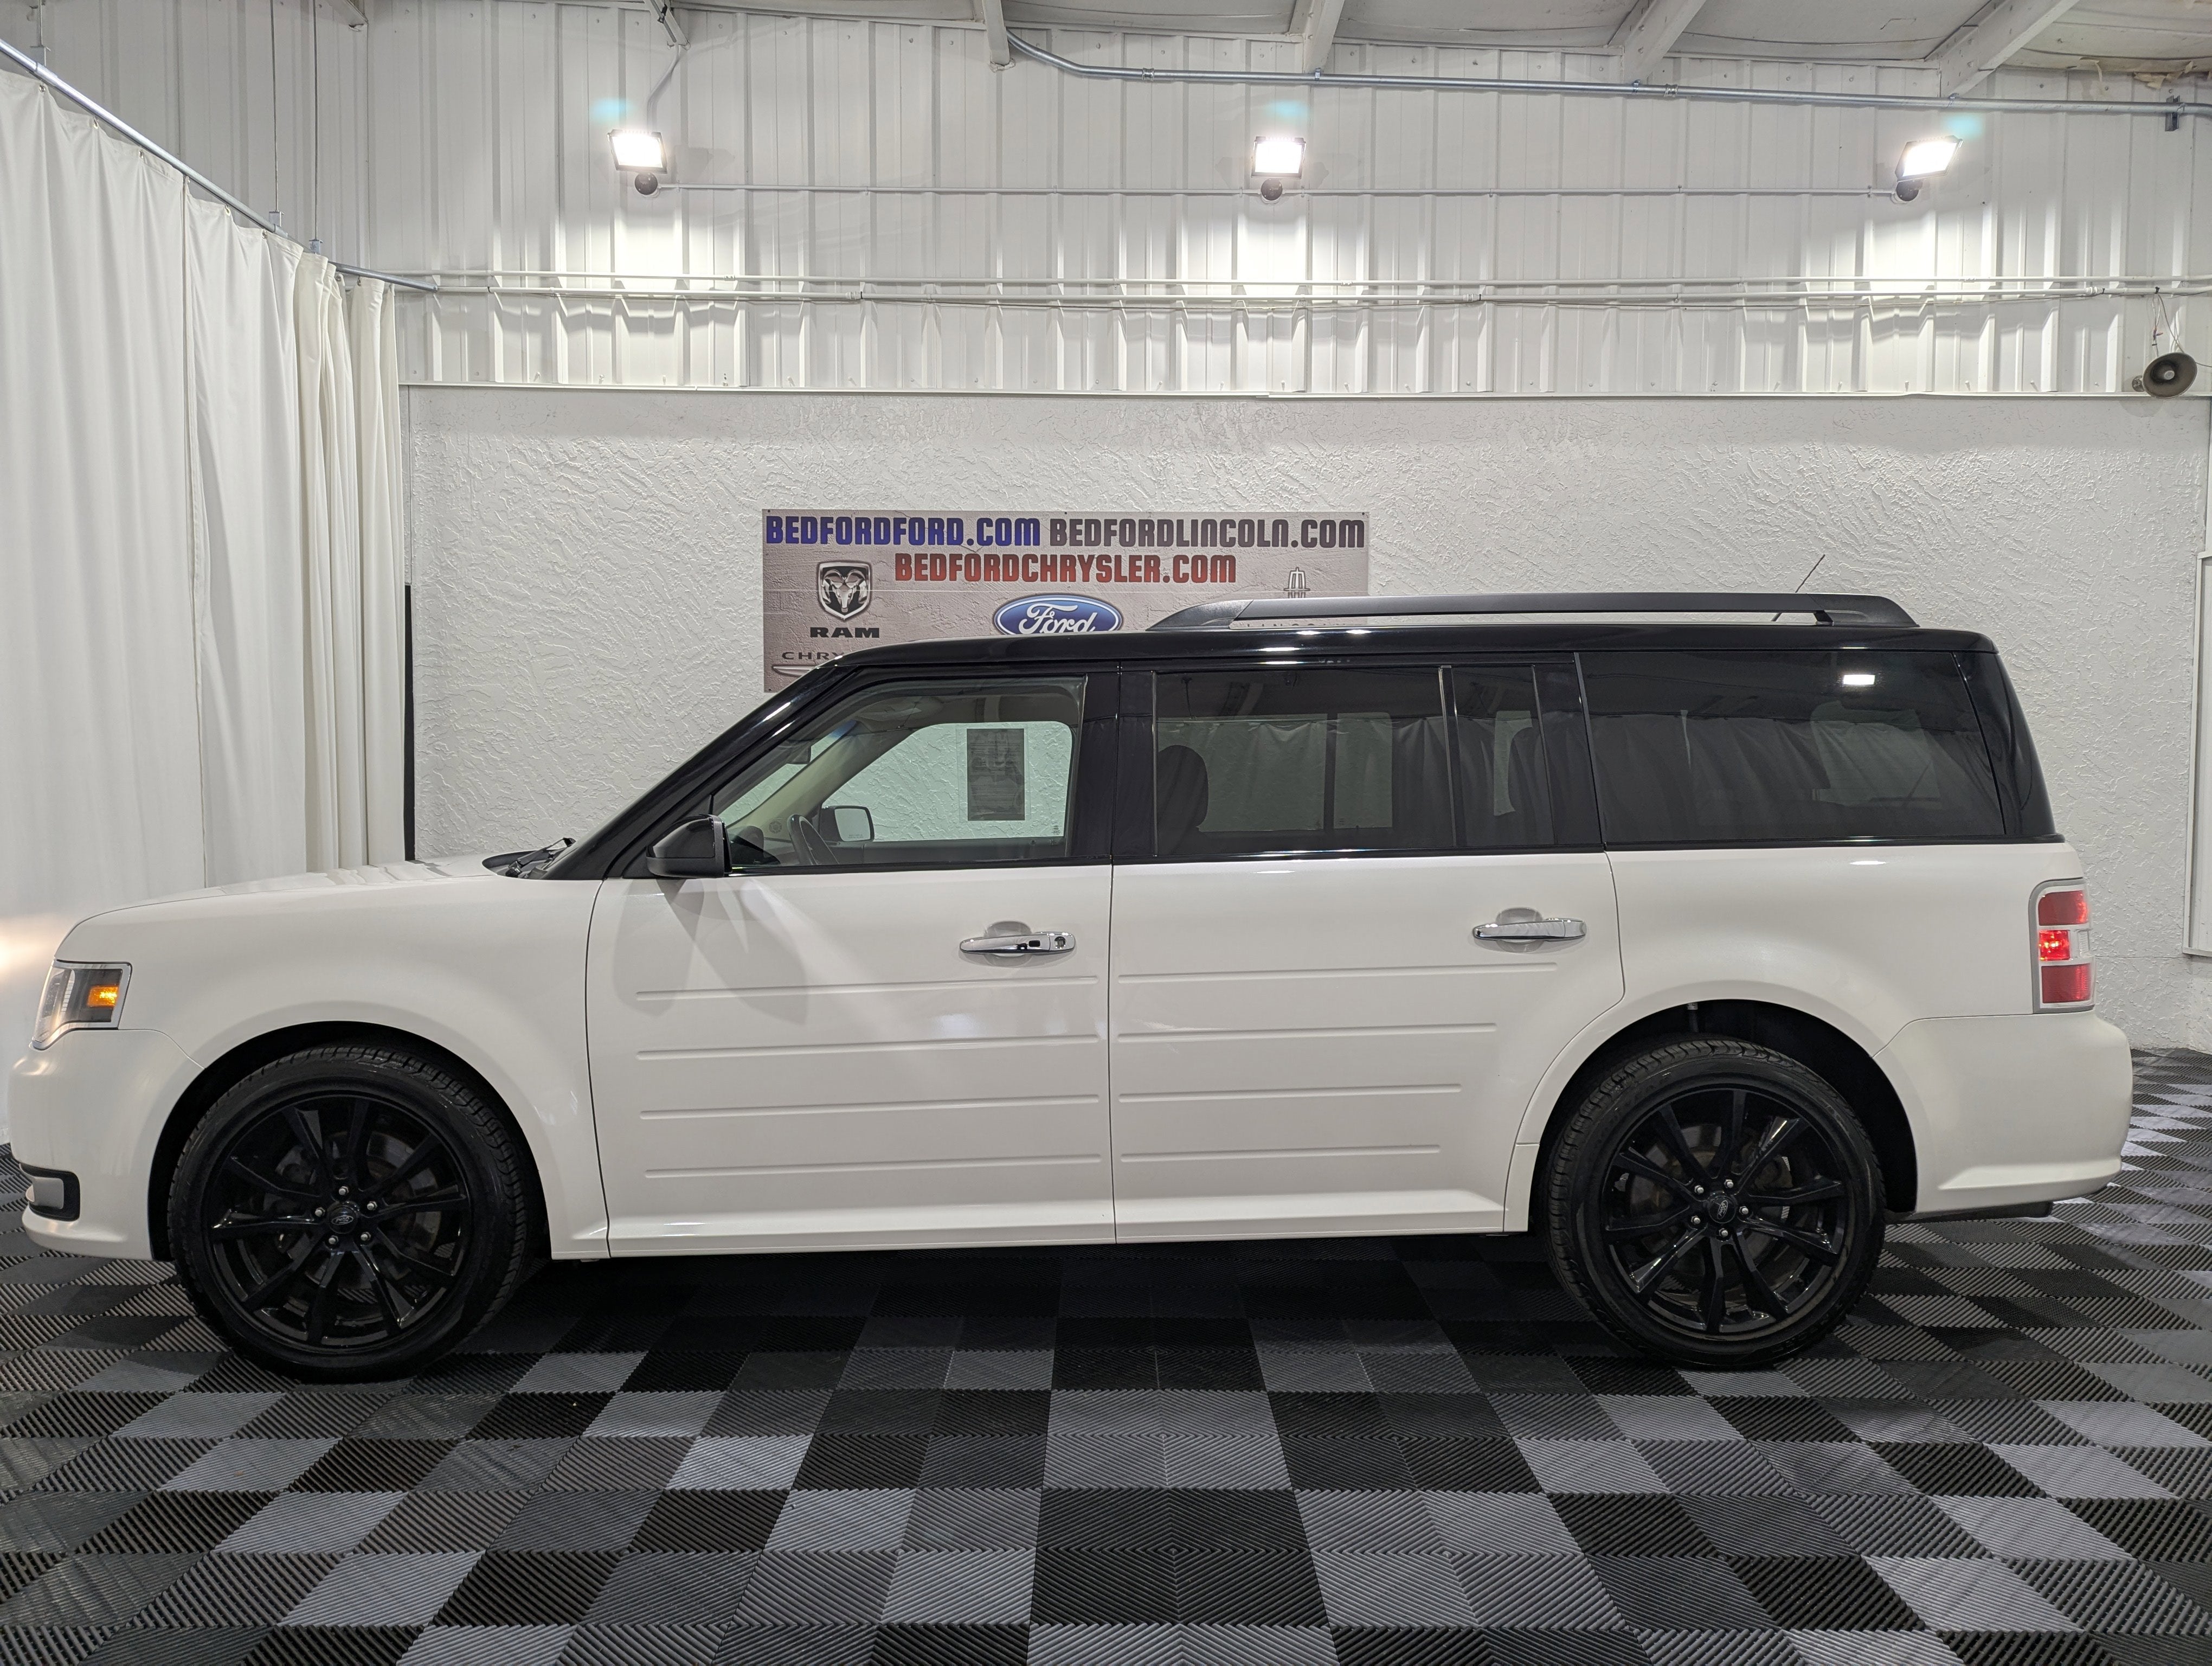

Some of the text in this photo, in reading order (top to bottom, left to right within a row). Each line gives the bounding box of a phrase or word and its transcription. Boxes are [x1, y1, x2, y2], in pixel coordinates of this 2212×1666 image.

[766, 516, 1365, 548] BEDFORDFORD.COM BEDFORDLINCOLN.COM
[895, 553, 1237, 584] BEDFORDCHRYSLER.COM
[810, 627, 880, 638] RAM
[1018, 603, 1098, 635] Ford
